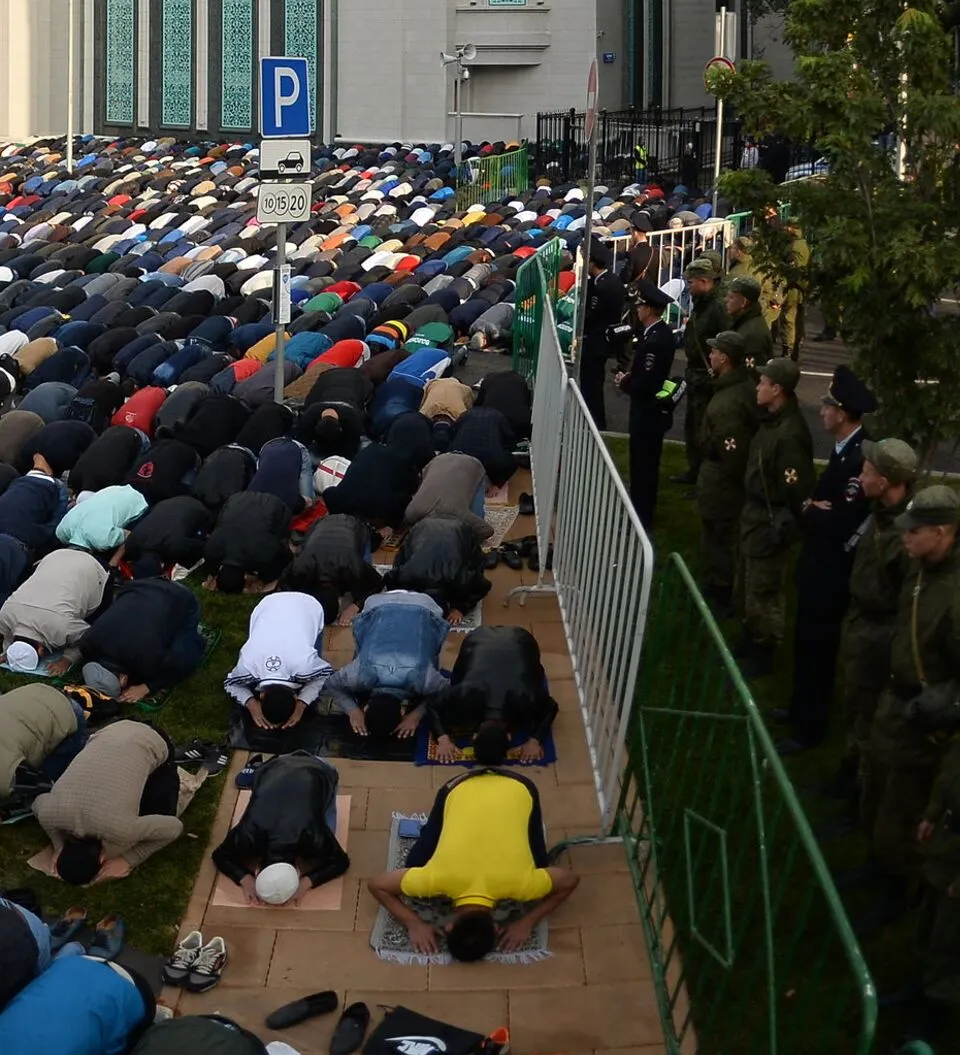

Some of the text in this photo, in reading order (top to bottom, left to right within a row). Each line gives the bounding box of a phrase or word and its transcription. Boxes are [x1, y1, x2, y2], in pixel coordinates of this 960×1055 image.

[274, 67, 300, 128] P
[264, 195, 305, 211] 10 15 20
